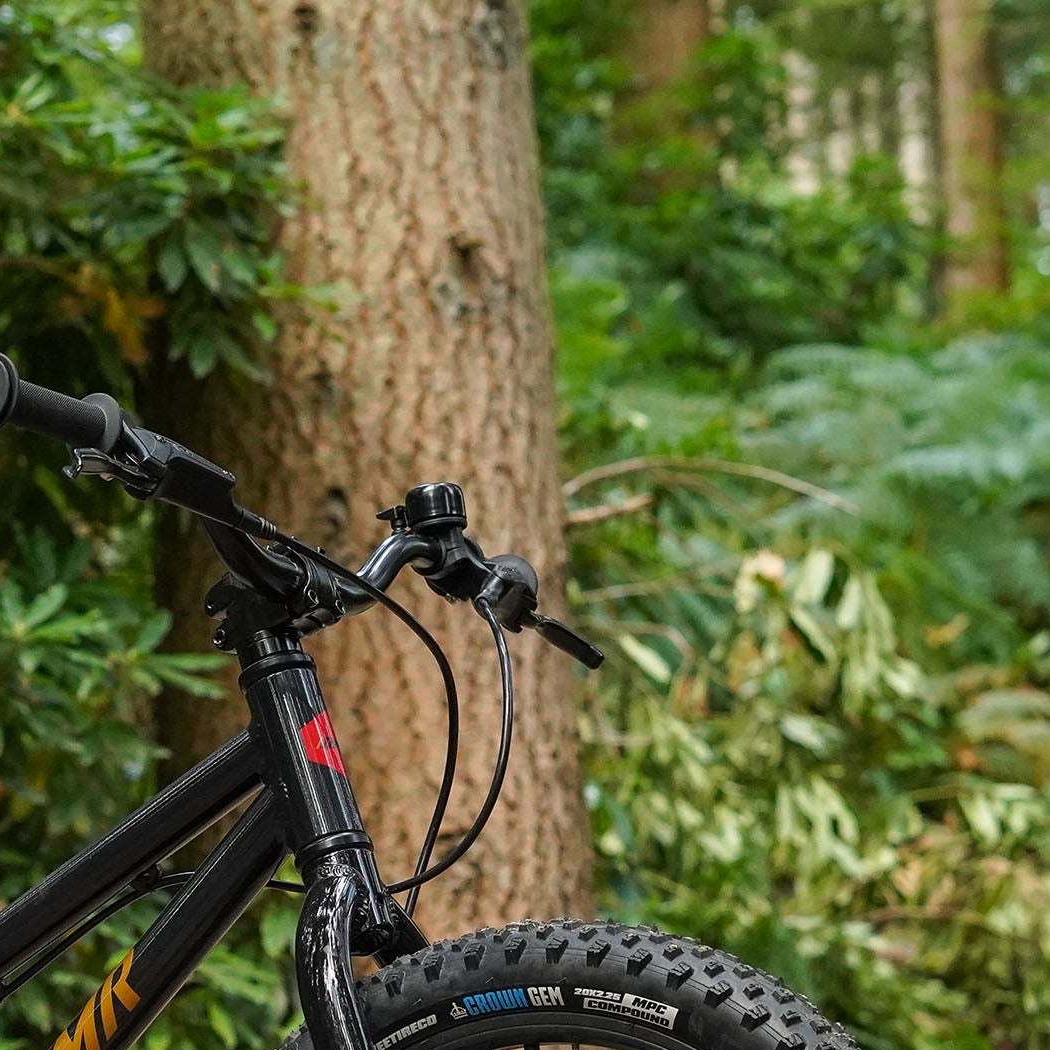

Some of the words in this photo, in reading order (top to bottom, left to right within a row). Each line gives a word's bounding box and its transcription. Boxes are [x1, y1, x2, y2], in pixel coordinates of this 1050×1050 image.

[463, 988, 529, 1016] CROWN
[527, 986, 565, 1006] GEM
[574, 987, 622, 1001] 20X2.25
[631, 997, 668, 1015] MPC
[587, 1000, 670, 1027] COMPOUND
